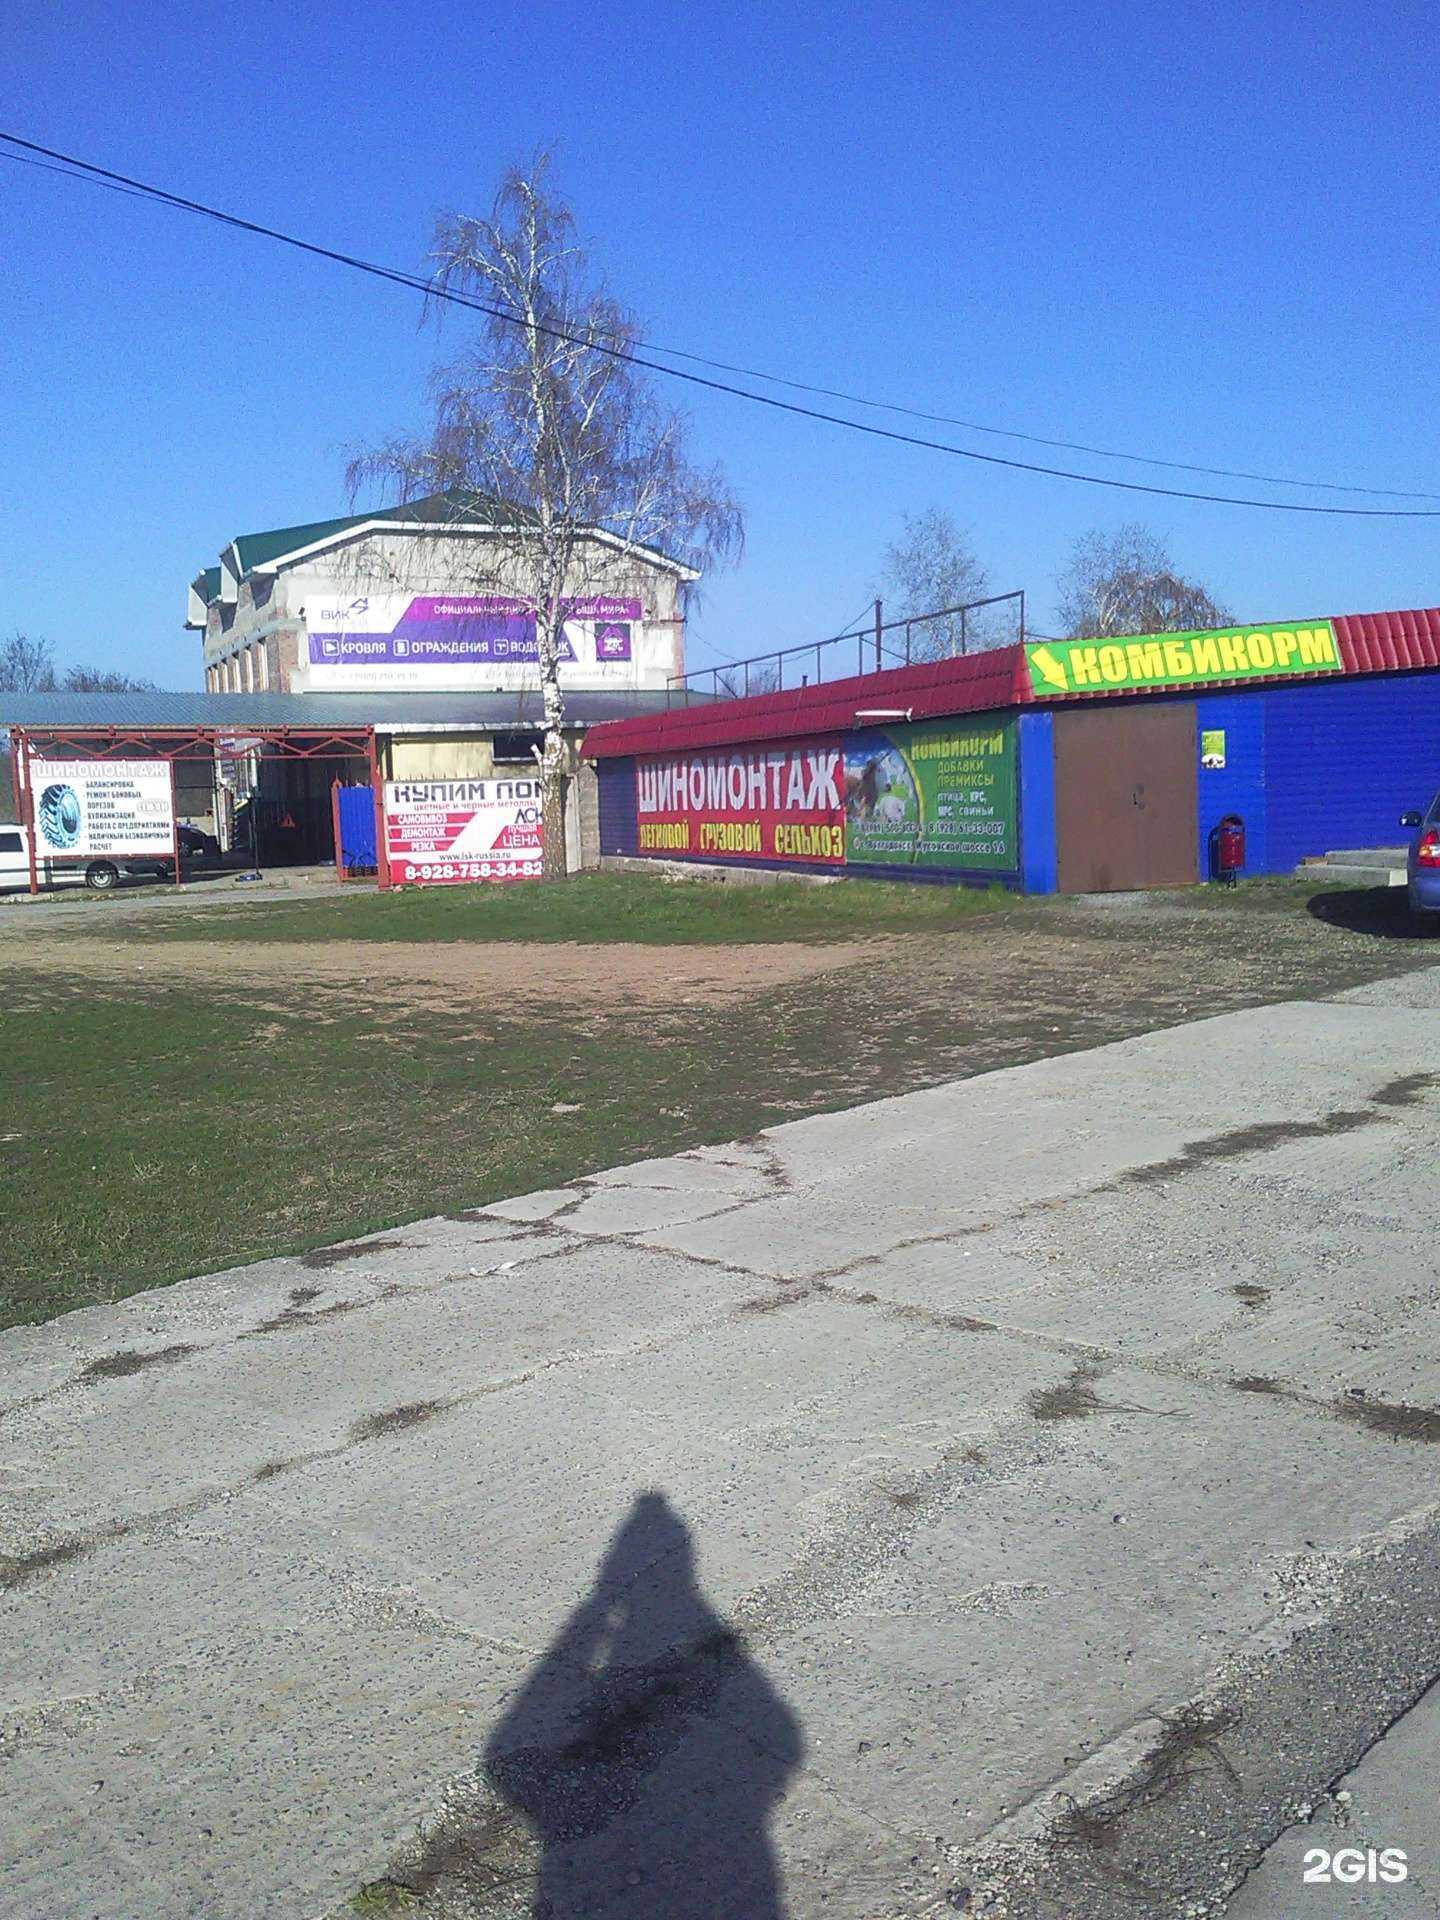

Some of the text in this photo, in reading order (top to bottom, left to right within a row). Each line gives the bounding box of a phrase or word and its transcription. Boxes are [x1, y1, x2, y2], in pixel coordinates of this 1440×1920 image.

[321, 609, 351, 620] ВИК
[341, 641, 386, 654] КРОВЛЯ
[411, 641, 489, 655] ОГРАЖДЕНИЯ
[1069, 628, 1335, 685] КОМБИКОРМ
[36, 762, 165, 777] ШИНОМОНТАЖ
[937, 760, 984, 774] ДОБАВКИ
[638, 749, 840, 813] ШИНОМОНТАЖ
[937, 774, 994, 787] ПРЕМИКСЫ
[394, 783, 486, 803] КУПИМ
[397, 813, 448, 825] САМОВЫВОЗ
[401, 826, 446, 839] ДЕМОНТАЖ
[639, 820, 689, 850] ЛЕГКОВОЙ
[700, 819, 761, 852] ГРУЗОВОЙ
[411, 841, 436, 852] РЕЗКА
[503, 833, 540, 848] ЦЕНА
